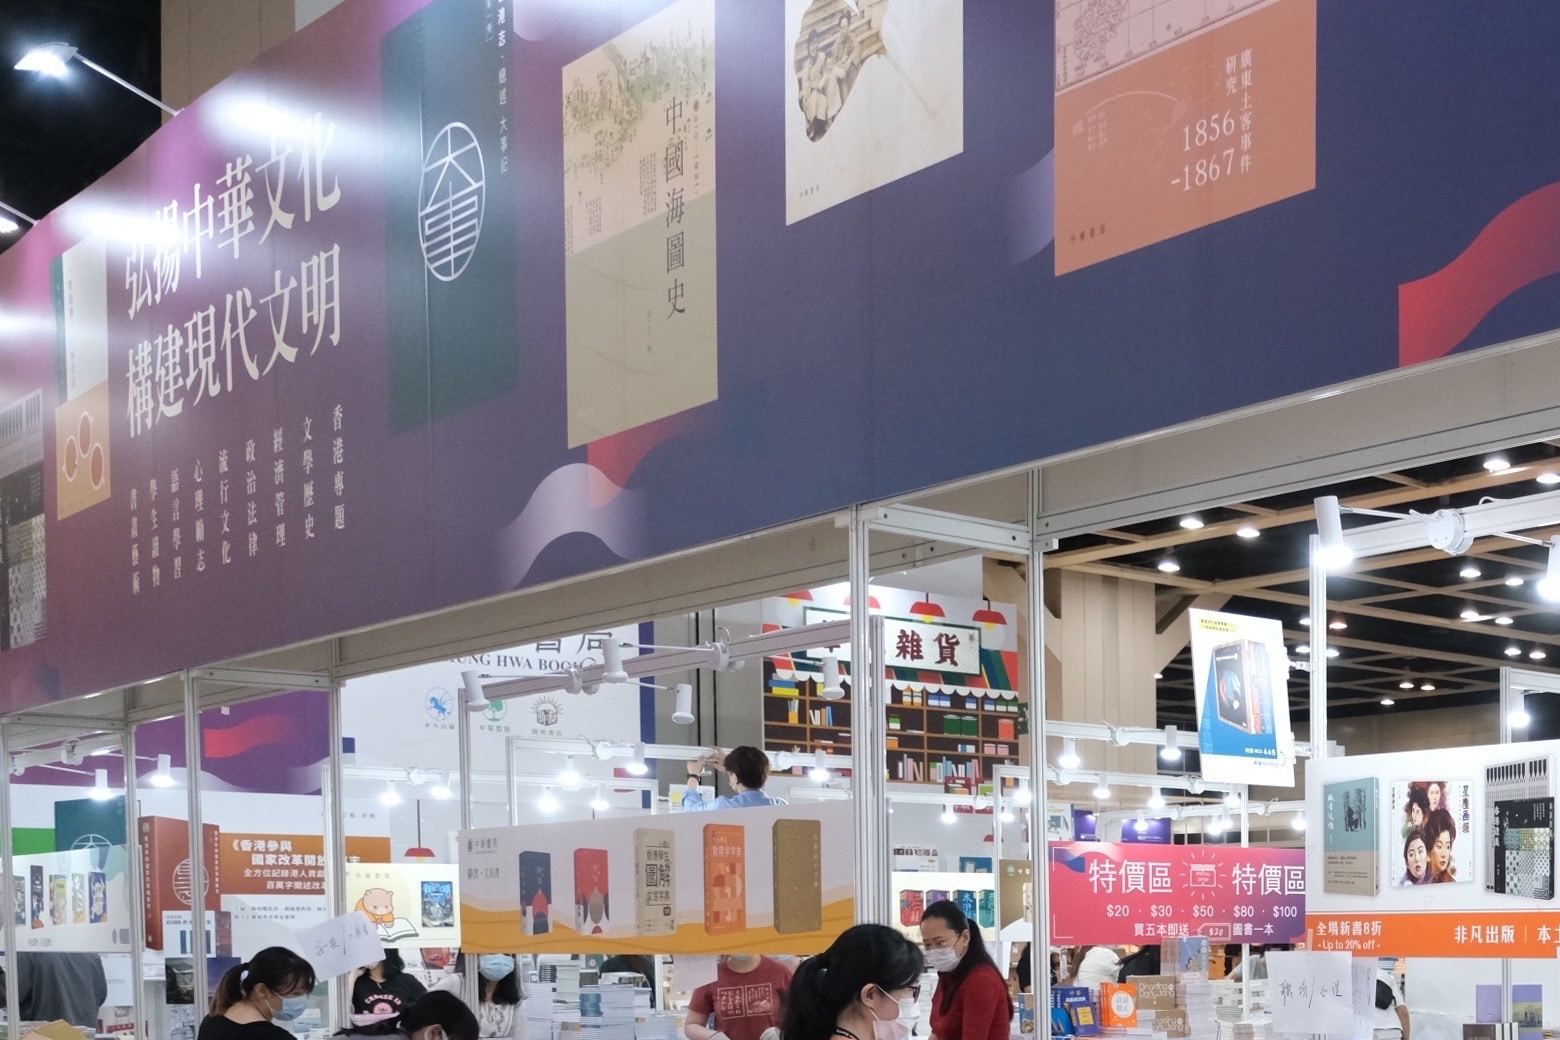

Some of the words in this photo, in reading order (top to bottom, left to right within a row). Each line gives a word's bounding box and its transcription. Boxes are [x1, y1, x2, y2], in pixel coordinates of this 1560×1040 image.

[1183, 109, 1235, 151] 1856
[126, 112, 341, 320] 弘揚中華文化
[665, 96, 686, 320] 中國海圖史
[127, 242, 341, 438] 構建現代文明
[273, 427, 286, 548] 經濟管理
[302, 416, 315, 540] 文學歷史
[332, 404, 346, 530] 香港專題
[218, 449, 231, 565] 流行文化
[245, 439, 259, 557] 政治法律
[170, 468, 182, 579] 語言學習
[497, 654, 533, 670] HWA
[896, 629, 961, 668] 雜貨
[1088, 858, 1173, 894] 特價區
[1232, 863, 1305, 896] 特價區
[1106, 903, 1130, 918] $20
[1150, 904, 1173, 918] $30
[1192, 904, 1214, 918] $50
[1233, 904, 1254, 918] $80
[1272, 905, 1298, 918] $100
[1134, 923, 1190, 938] 買五本即送
[1233, 923, 1274, 936] 圖書一本
[1316, 920, 1382, 937] 全場新書8折
[1345, 939, 1362, 950] 20%
[1454, 926, 1515, 944] 非凡出版
